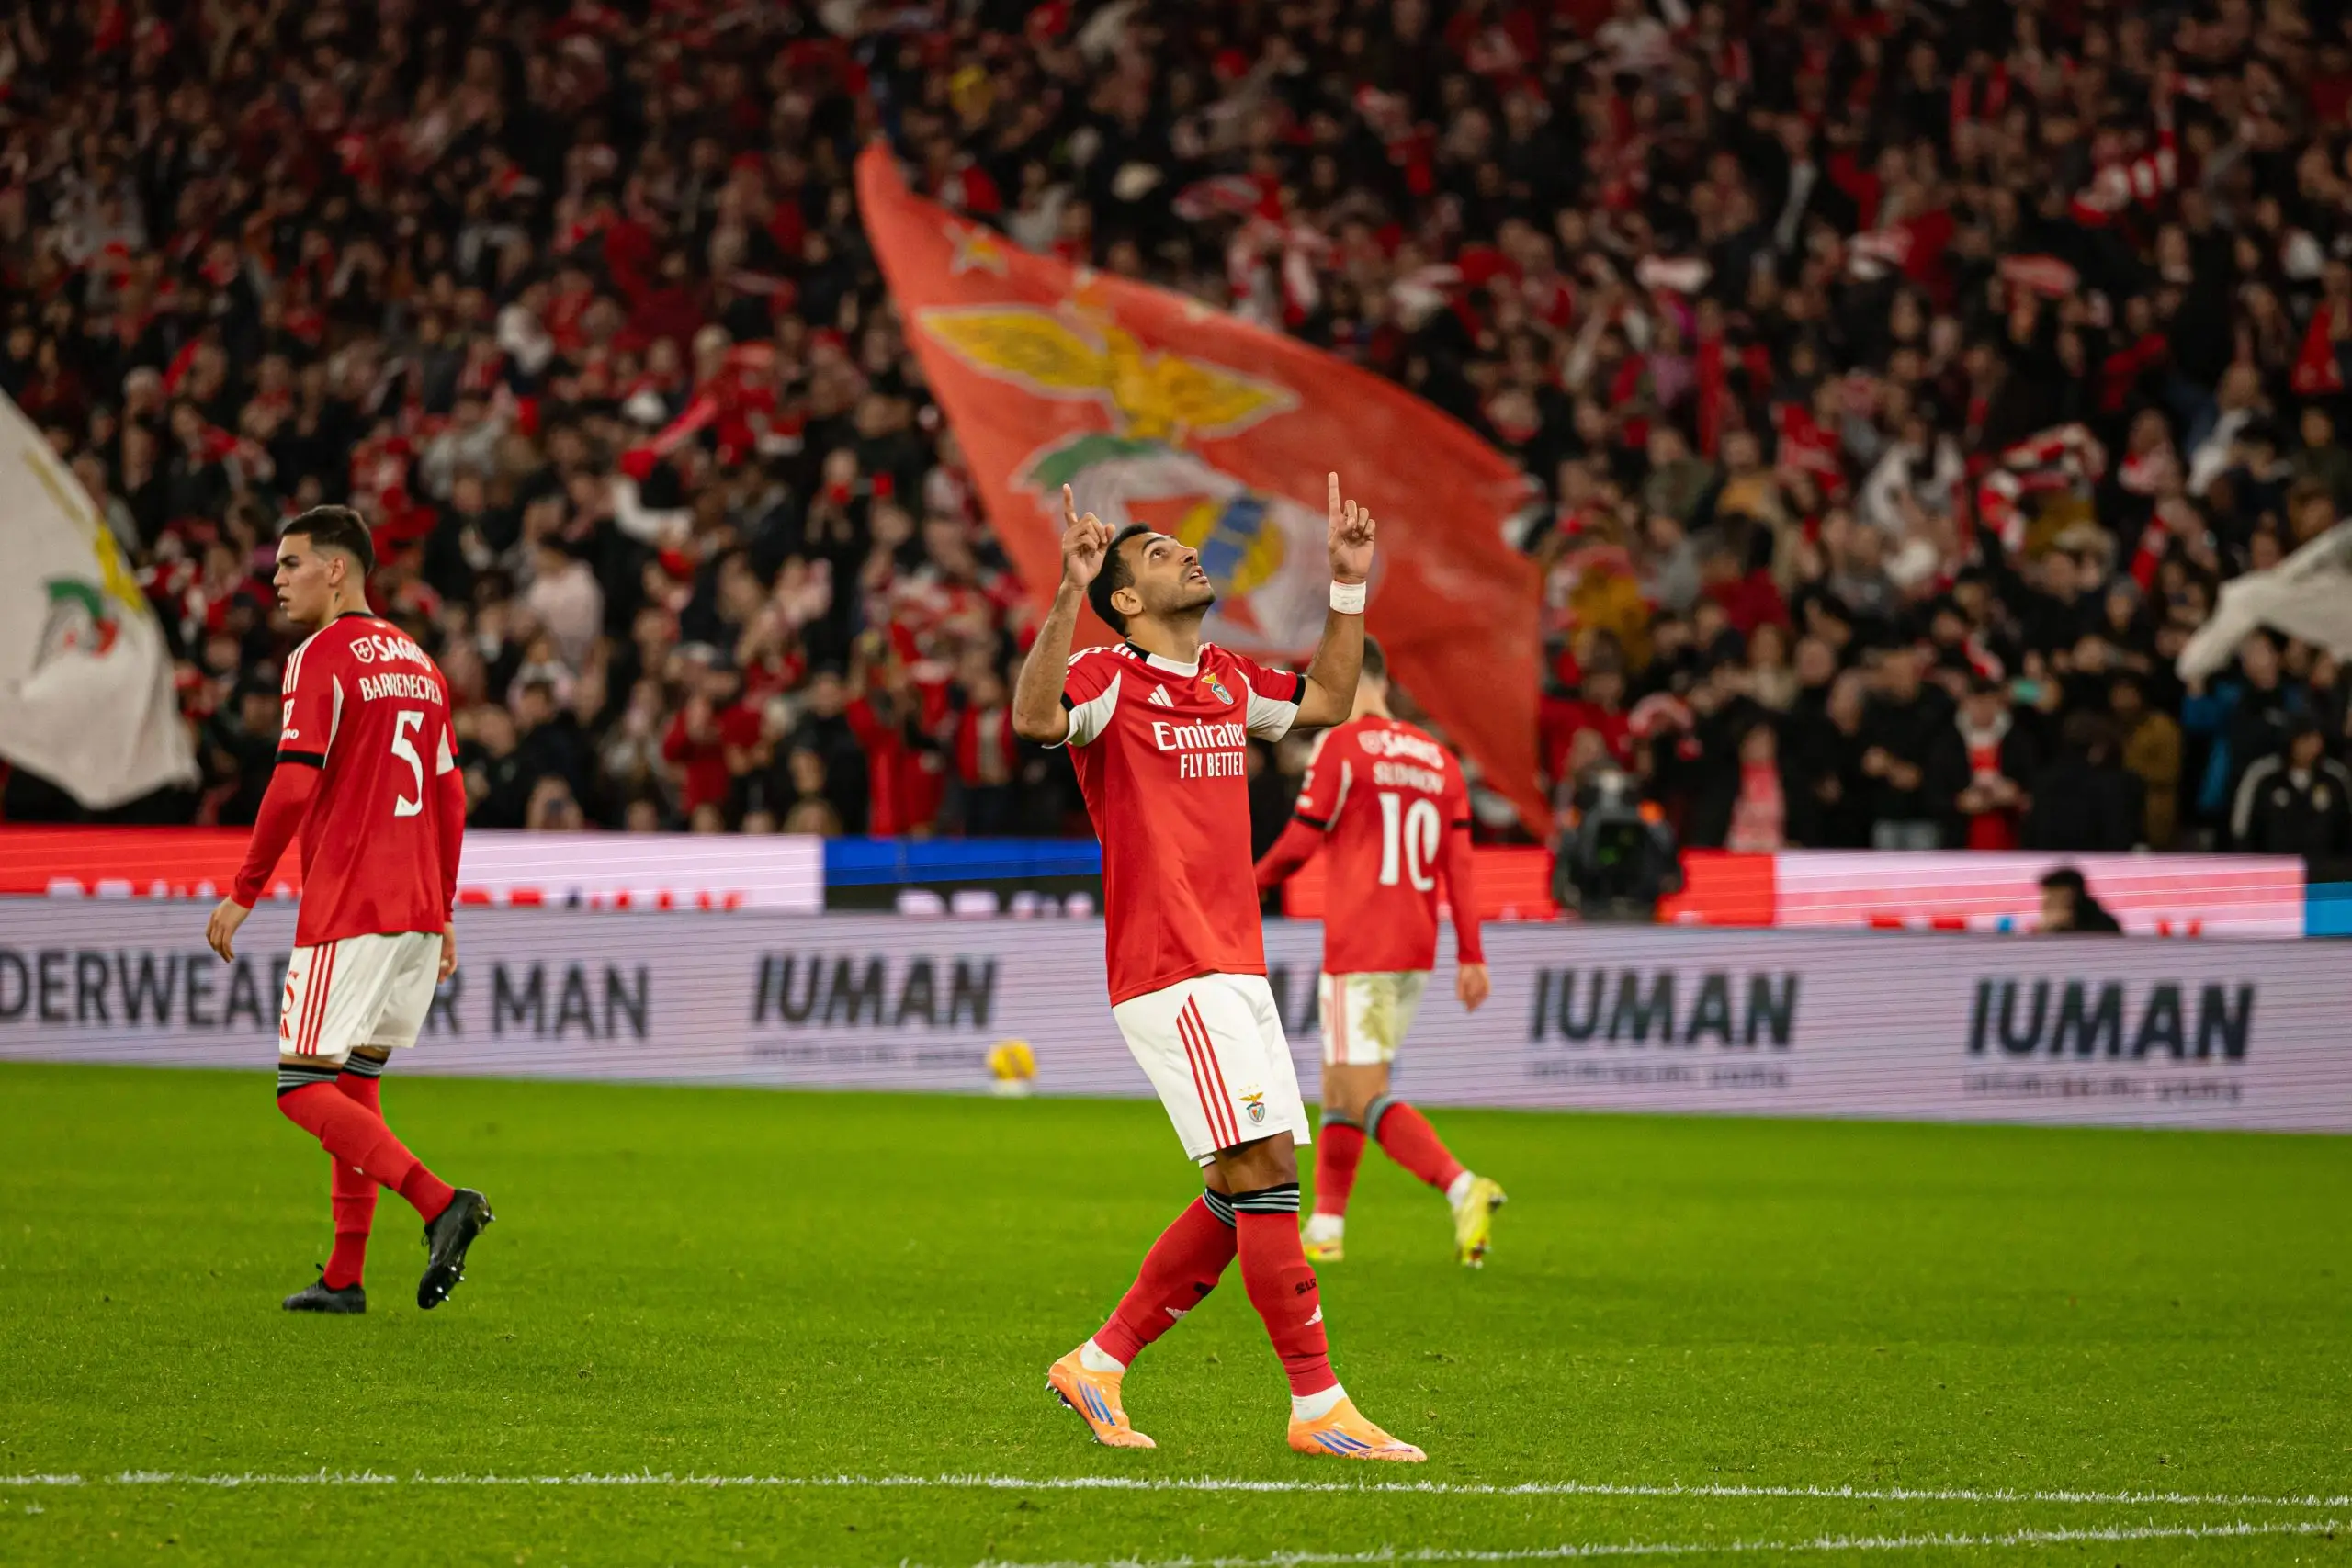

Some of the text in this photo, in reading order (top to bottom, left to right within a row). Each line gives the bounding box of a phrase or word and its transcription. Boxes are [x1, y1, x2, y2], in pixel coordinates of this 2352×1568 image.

[391, 711, 424, 817] 5
[1151, 717, 1246, 750] Emirates
[1180, 751, 1244, 779] FLY BETTER
[1379, 792, 1441, 891] 10
[492, 961, 650, 1039] MAN
[751, 953, 999, 1031] IUMAN
[1529, 967, 1799, 1047] IUMAN
[1967, 976, 2256, 1061] IUMAN
